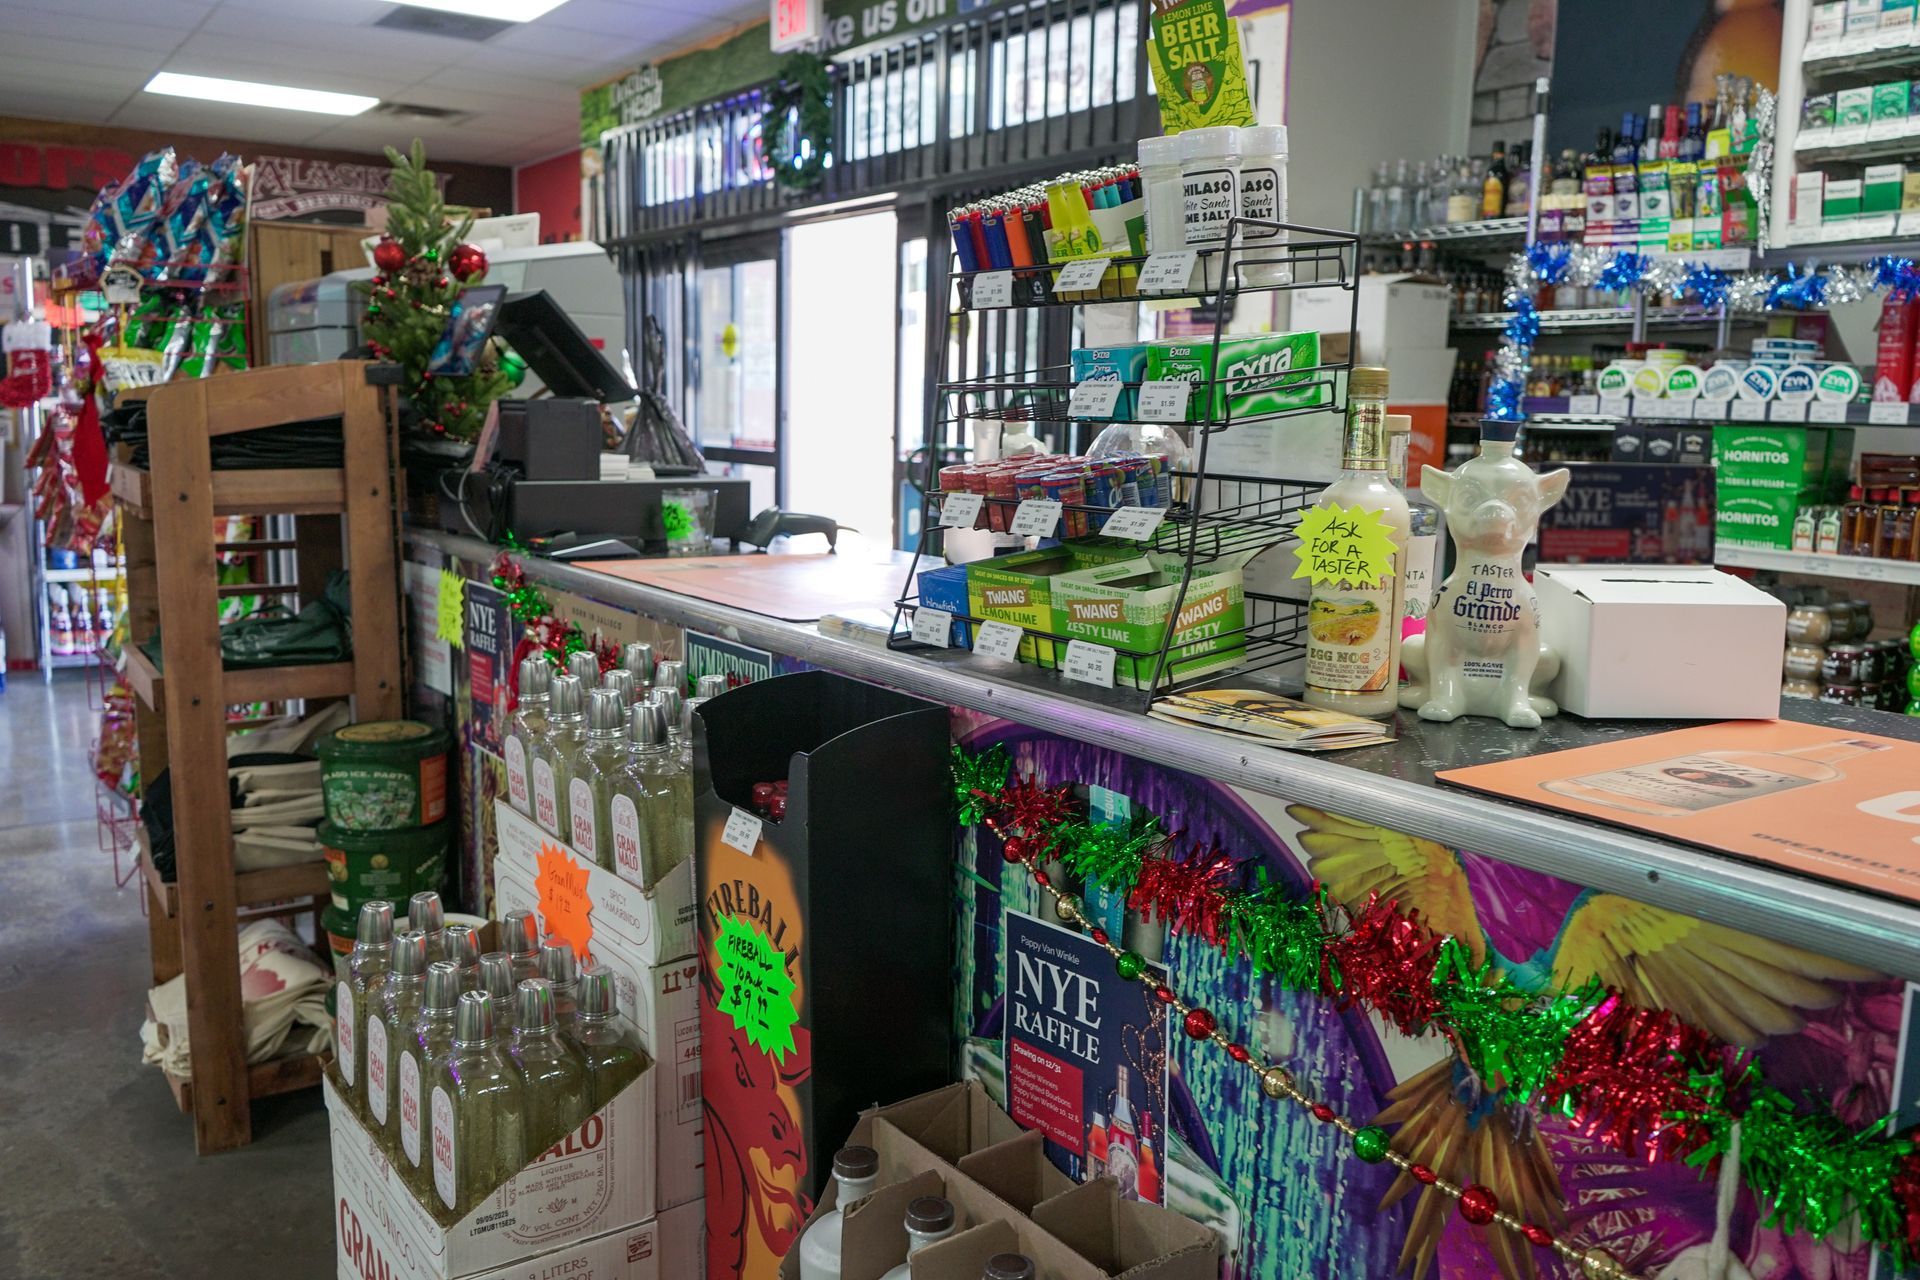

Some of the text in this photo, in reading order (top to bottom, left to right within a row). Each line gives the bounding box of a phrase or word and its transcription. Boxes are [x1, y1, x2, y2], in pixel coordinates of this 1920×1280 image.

[862, 2, 897, 37] us
[1163, 9, 1191, 23] LEMON
[1193, 2, 1214, 15] LIME
[1161, 13, 1220, 48] BEER
[1168, 37, 1219, 71] SALT
[1200, 196, 1230, 210] Sands
[1203, 210, 1230, 222] SALT
[1169, 347, 1190, 357] Extra
[1226, 346, 1292, 395] Extra
[1670, 373, 1694, 386] ZYN
[1784, 374, 1809, 387] ZYN
[1826, 373, 1851, 387] ZYN
[1724, 450, 1790, 464] HORNITOS
[1321, 516, 1362, 538] ASK
[1716, 511, 1780, 527] HORNITOS
[1311, 537, 1362, 559] FOR A
[1164, 564, 1184, 574] GREAT
[1312, 555, 1371, 578] TASTER
[1472, 564, 1515, 578] TASTER
[1199, 580, 1214, 590] SALT
[1466, 580, 1513, 602] El Perro
[986, 590, 1026, 604] TWANG
[470, 601, 497, 636] NYE
[979, 606, 1038, 625] LEMON LIME
[1073, 603, 1119, 619] TWANG
[1177, 597, 1224, 629] TWANG
[1453, 595, 1521, 621] Grande
[1066, 620, 1131, 644] ZESTY LIME
[1176, 621, 1221, 646] ZESTY
[1468, 621, 1504, 629] BLANCO
[1468, 626, 1502, 634] TEQUILA
[470, 630, 497, 654] RAFFLE
[1182, 640, 1217, 658] LIME
[1310, 647, 1370, 664] EGG NOG
[574, 814, 592, 834] GRAN
[575, 829, 593, 851] MALO
[616, 833, 637, 854] GRAN
[618, 851, 638, 872] MALO
[609, 888, 626, 906] SPICY
[600, 897, 641, 930] TAMARINDO
[705, 879, 801, 978] FIREBALL
[728, 934, 774, 972] FIREBALL
[1020, 934, 1080, 965] Pappy Van Winkle
[1015, 950, 1101, 1030] NYE
[1014, 1001, 1100, 1065] RAFFLE
[1013, 1042, 1062, 1074] Drawing on 12/31
[1013, 1083, 1030, 1099] Pappy
[1040, 1097, 1060, 1113] Winkle
[530, 1112, 604, 1164] ALO
[1053, 1126, 1067, 1139] cash
[1066, 1134, 1080, 1147] only
[541, 1162, 574, 1177] LIQUEUR
[525, 1180, 543, 1190] MADE
[475, 1209, 509, 1226] 09/05/2025
[519, 1223, 530, 1233] BY
[554, 1214, 580, 1227] CONT
[583, 1201, 598, 1217] NET
[542, 1256, 589, 1279] LITERS
